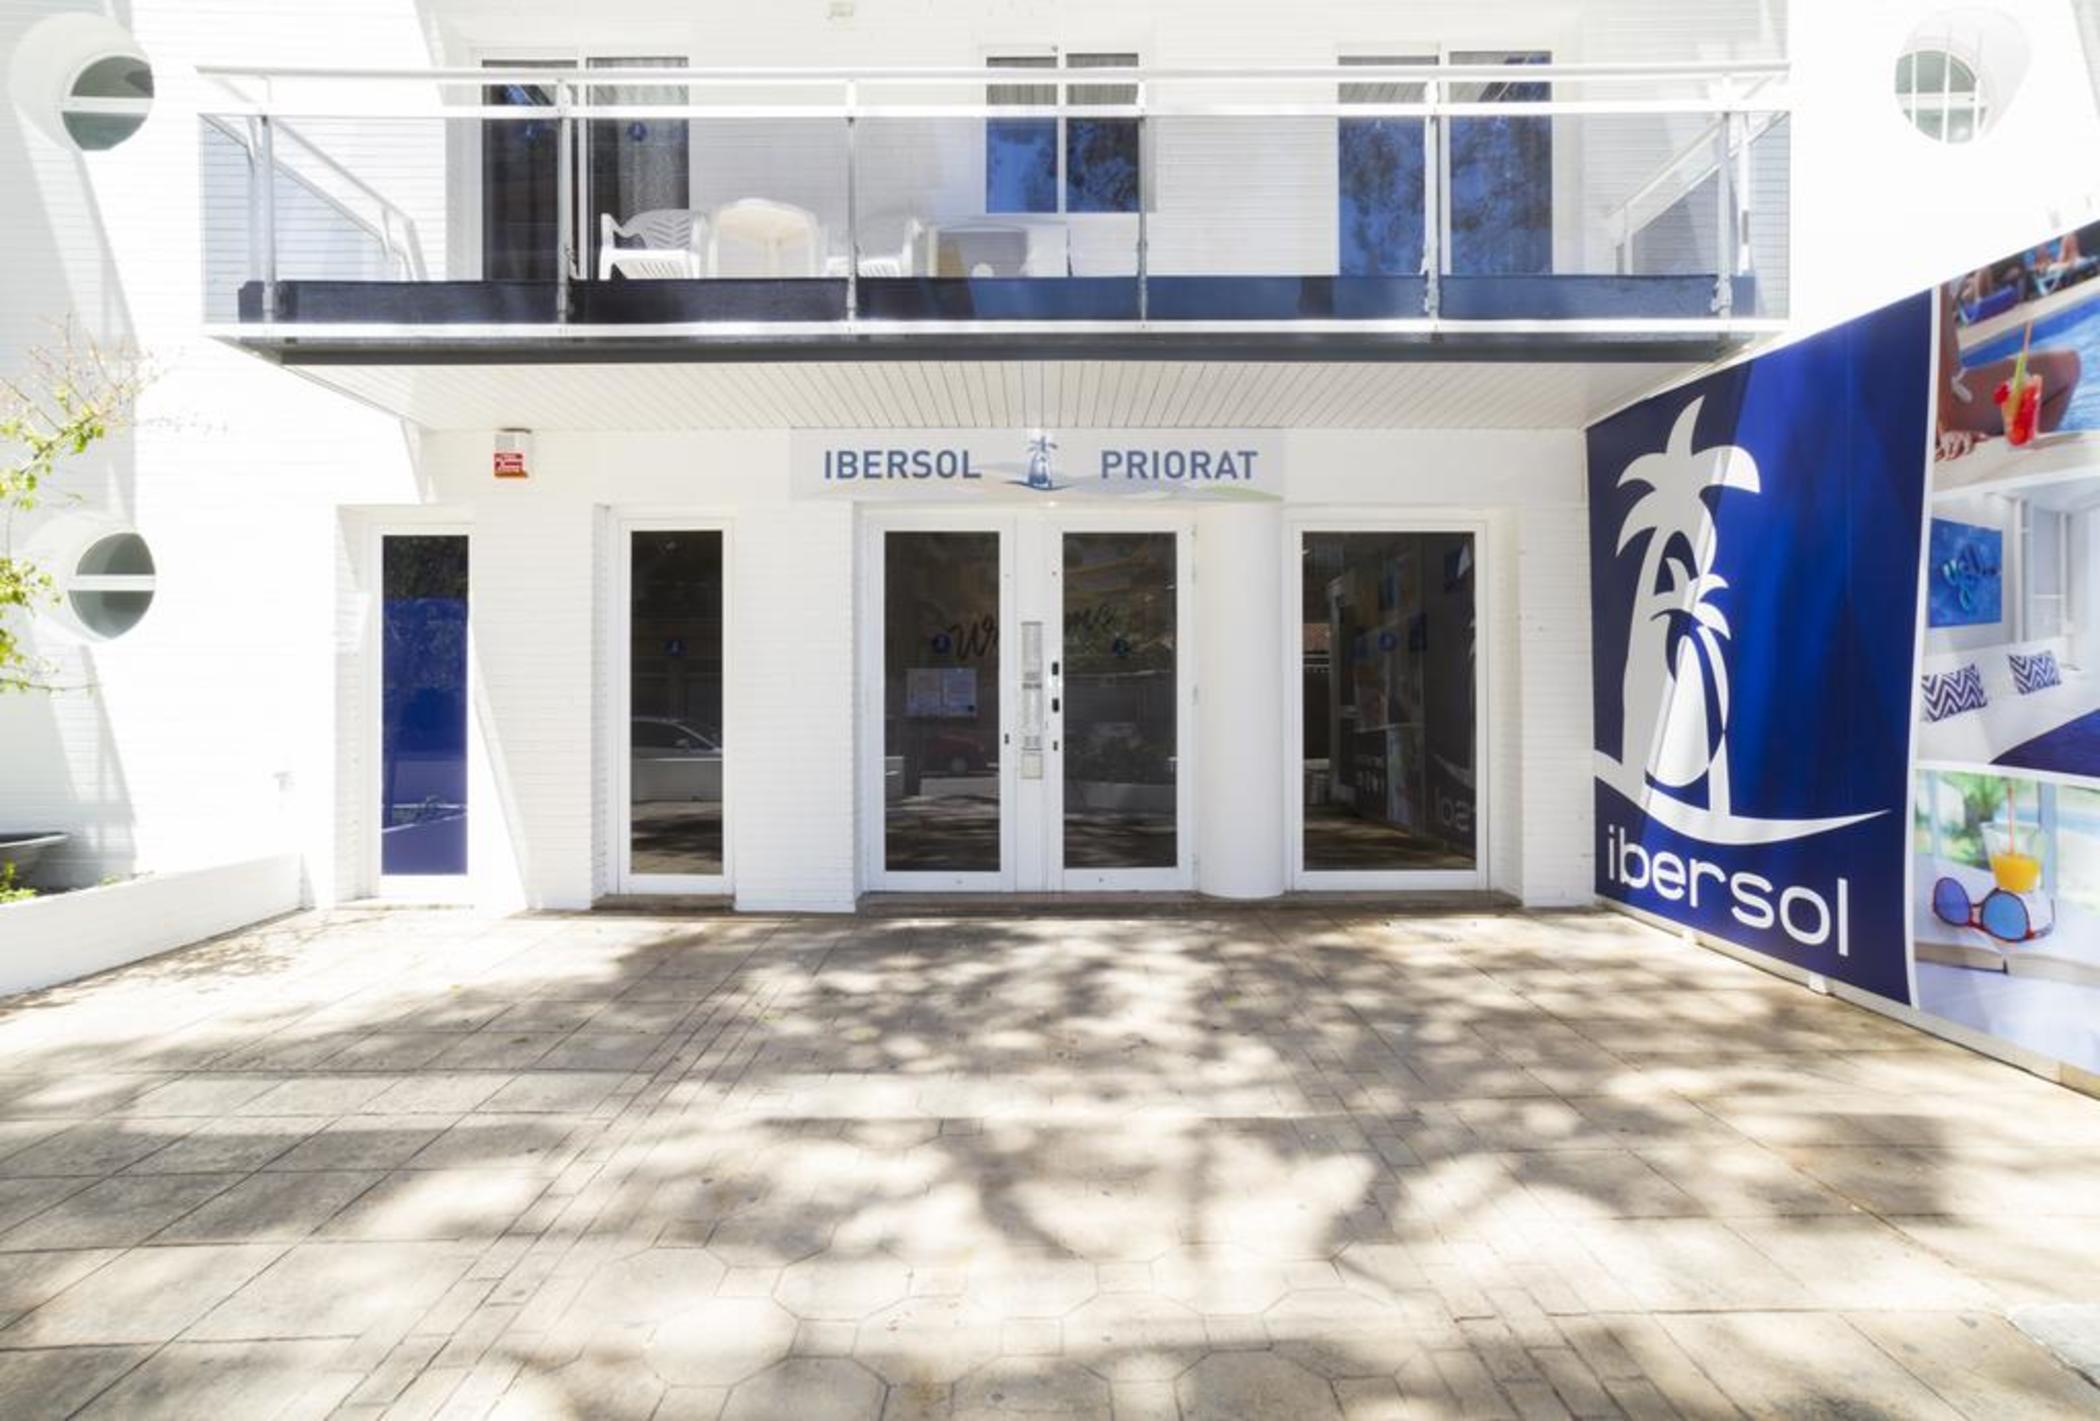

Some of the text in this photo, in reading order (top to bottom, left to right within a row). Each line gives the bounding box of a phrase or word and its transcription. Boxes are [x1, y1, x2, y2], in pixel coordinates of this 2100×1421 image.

[824, 450, 1258, 480] IBERSOL PRIORAT
[1607, 823, 1849, 957] ibersol
